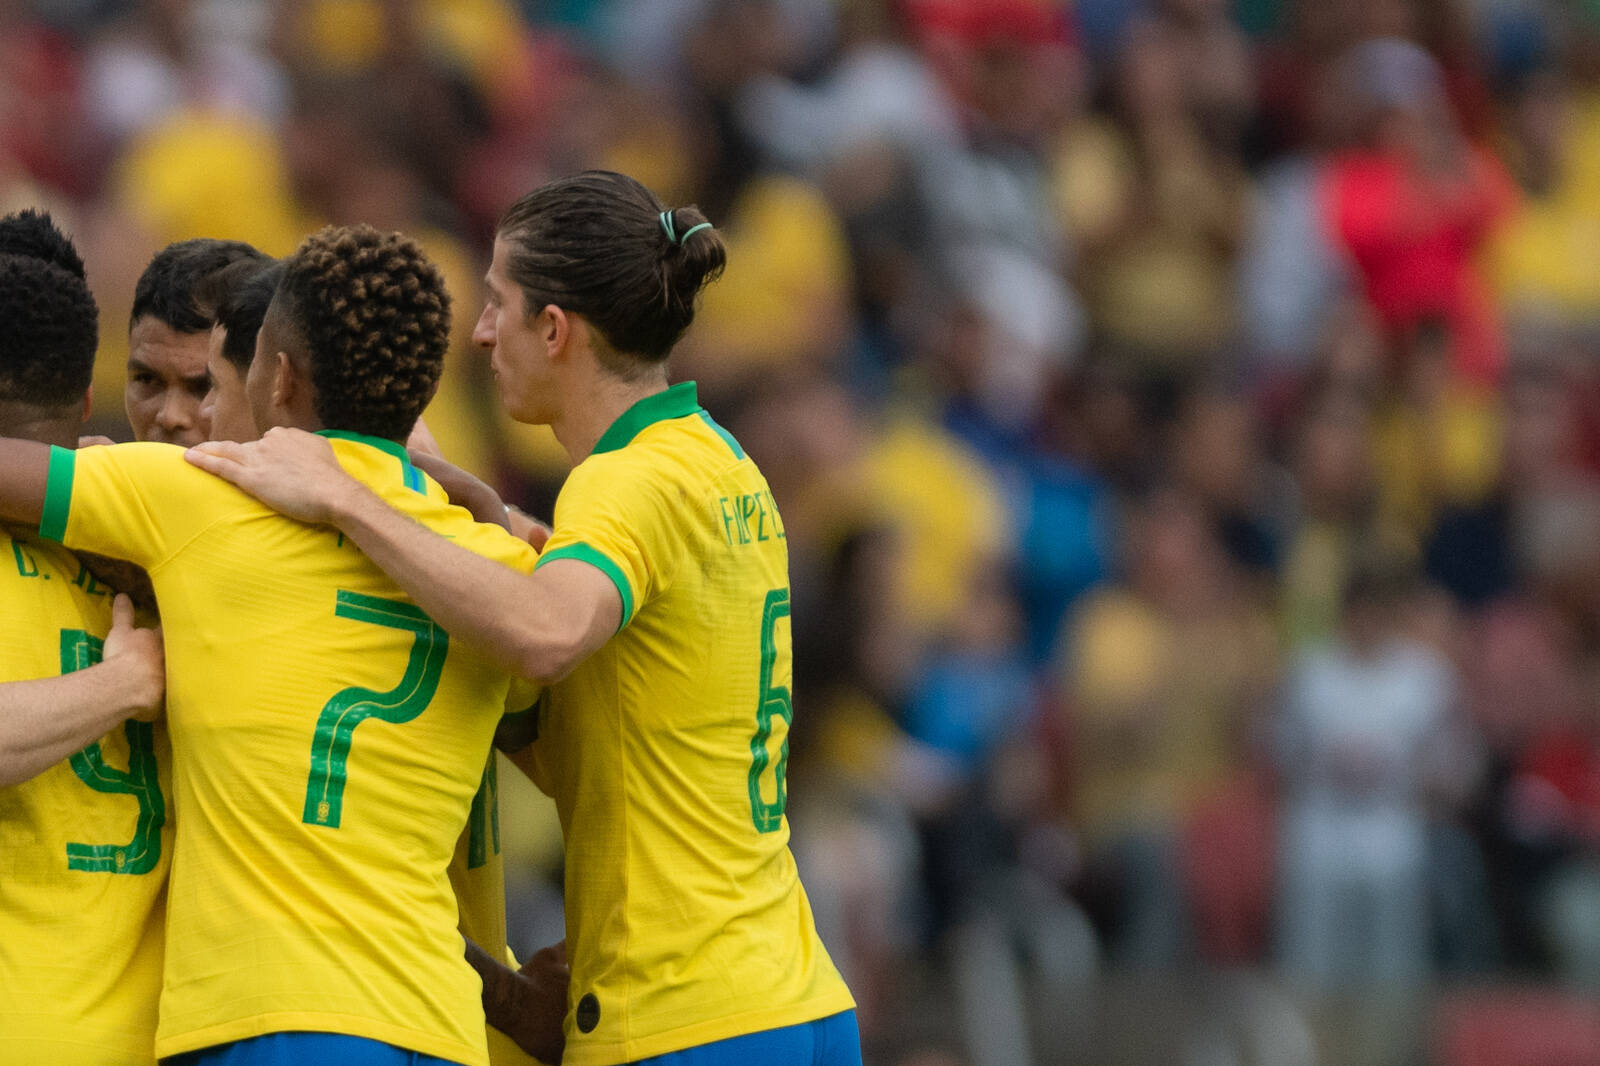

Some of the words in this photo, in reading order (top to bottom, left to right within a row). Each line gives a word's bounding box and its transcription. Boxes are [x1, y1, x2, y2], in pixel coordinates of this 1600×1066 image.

[60, 629, 166, 875] 9
[302, 589, 449, 829] 7
[747, 587, 793, 834] 6
